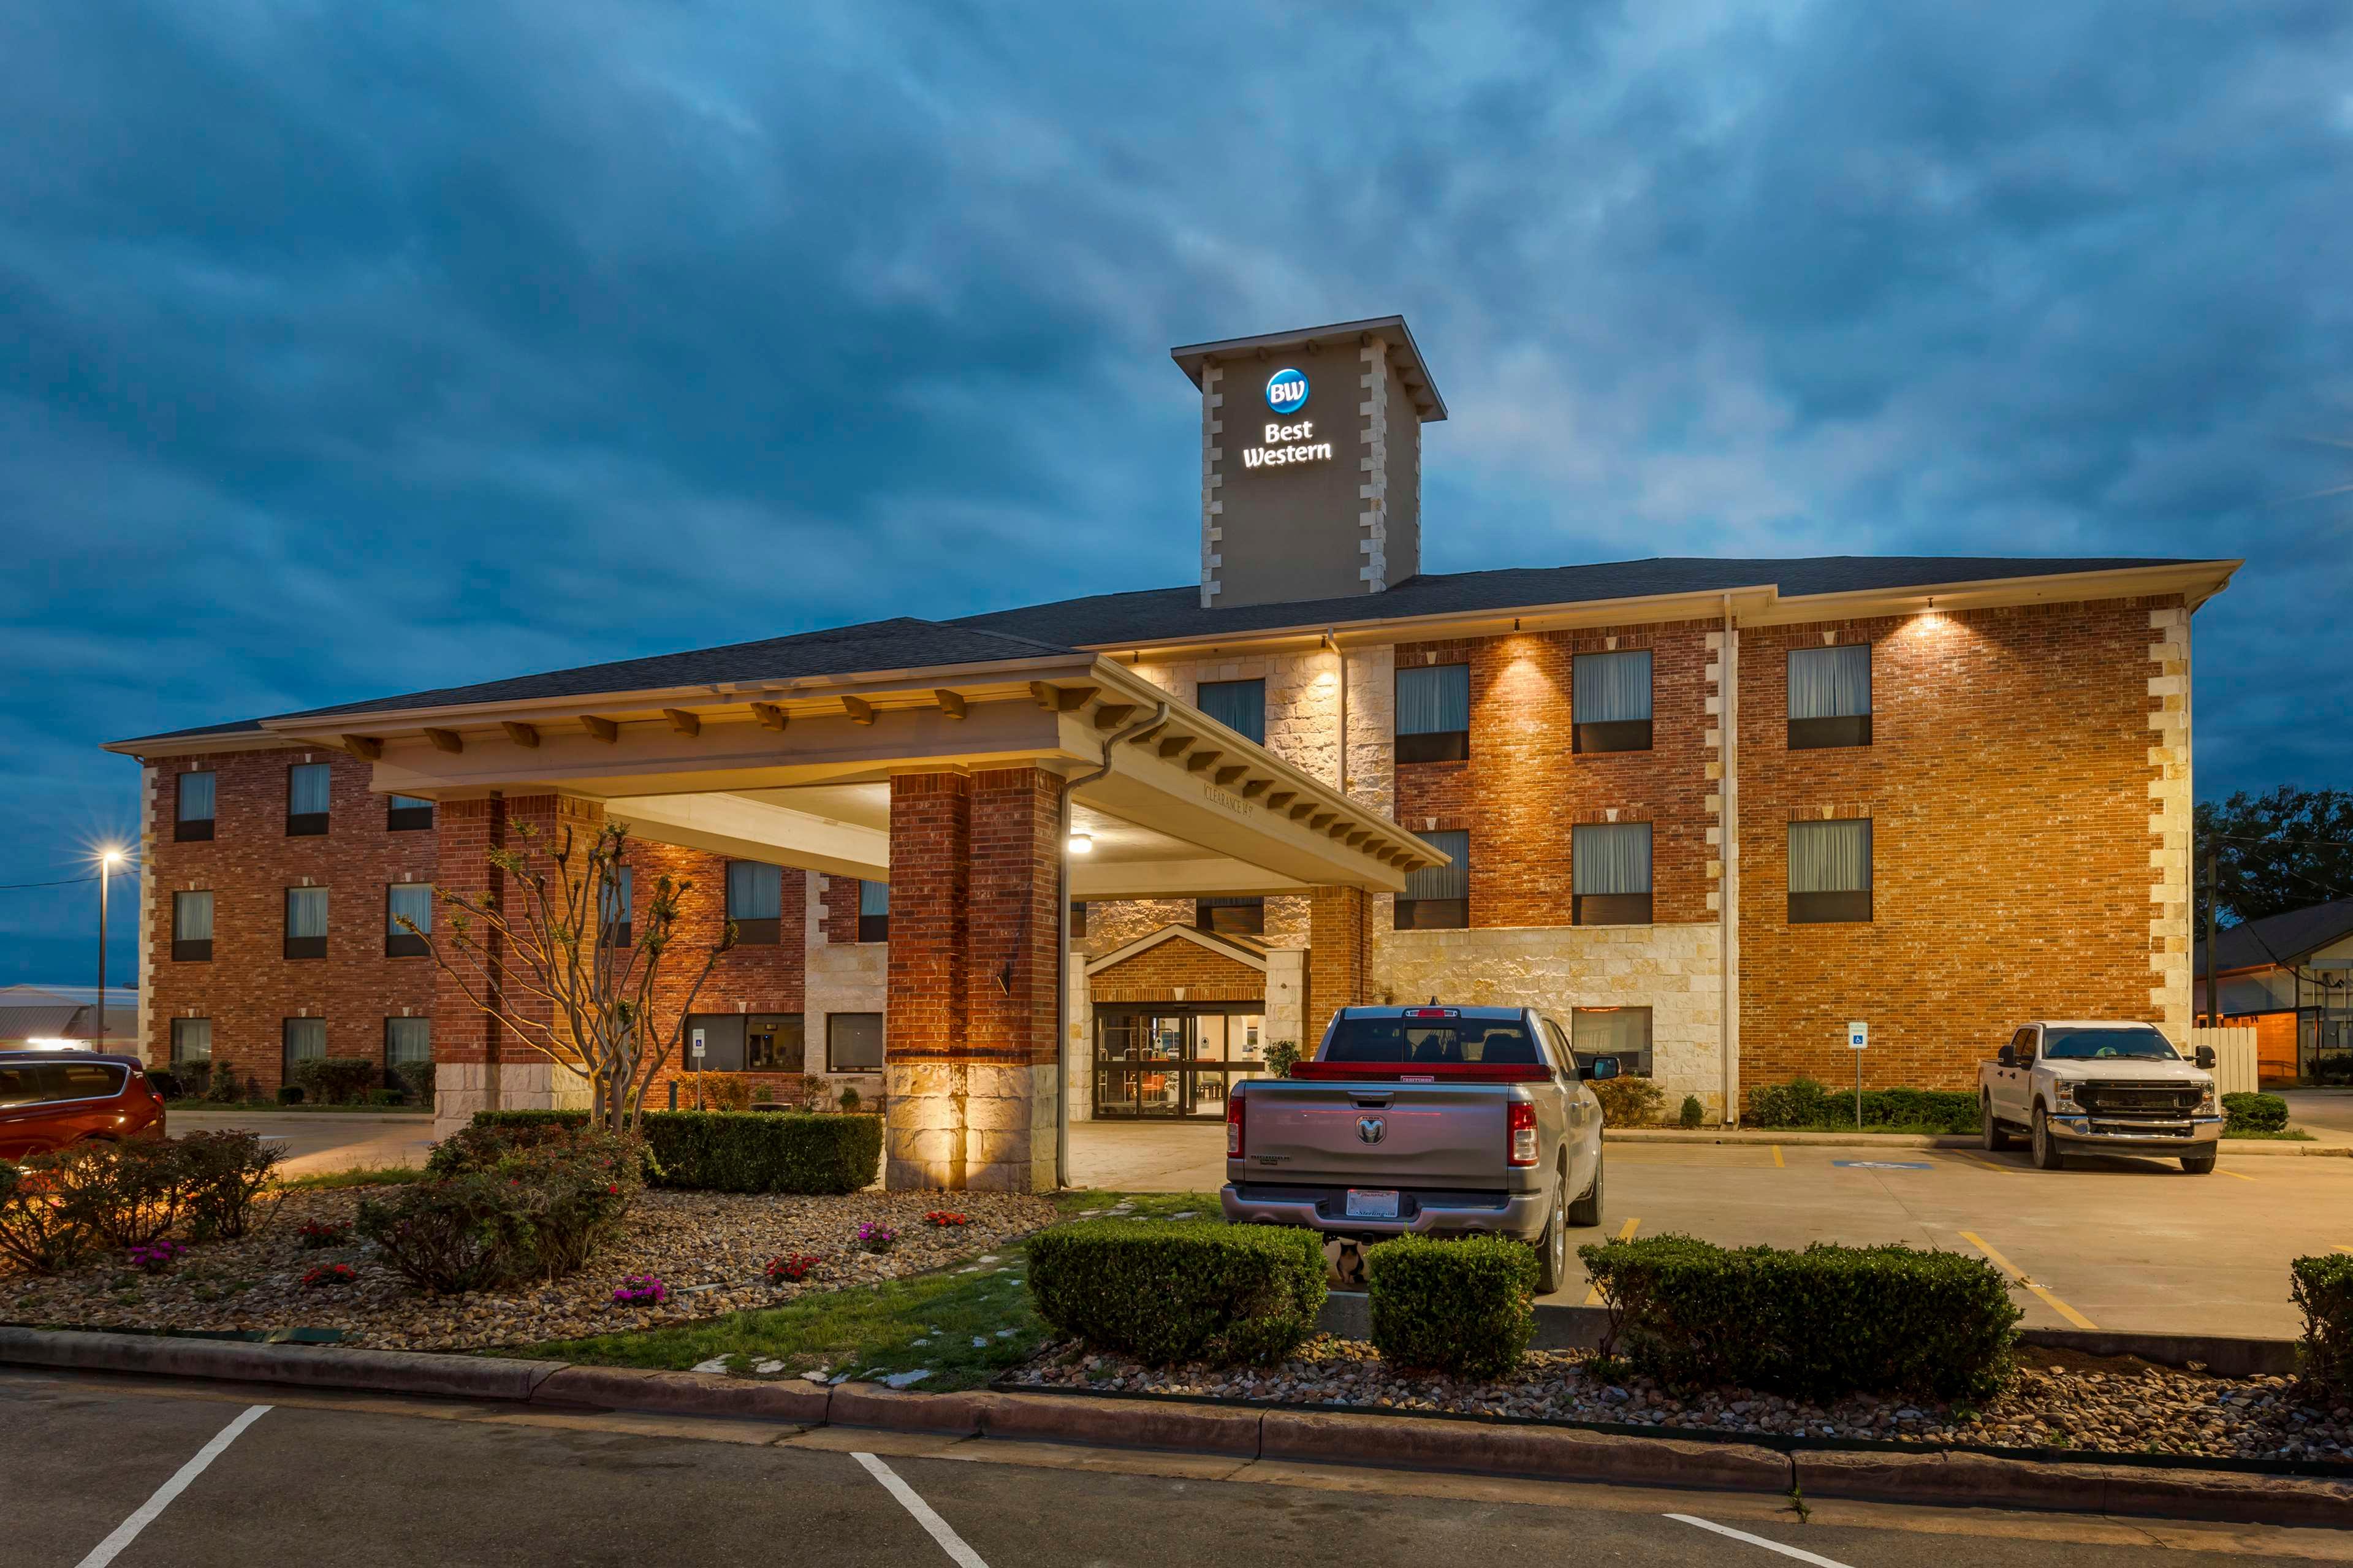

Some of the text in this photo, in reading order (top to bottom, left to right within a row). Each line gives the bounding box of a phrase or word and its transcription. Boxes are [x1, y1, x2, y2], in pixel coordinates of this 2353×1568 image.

[1271, 381, 1305, 403] BW
[1265, 421, 1313, 443] Best
[1243, 443, 1332, 468] Western
[1205, 786, 1241, 815] CLEARANCE
